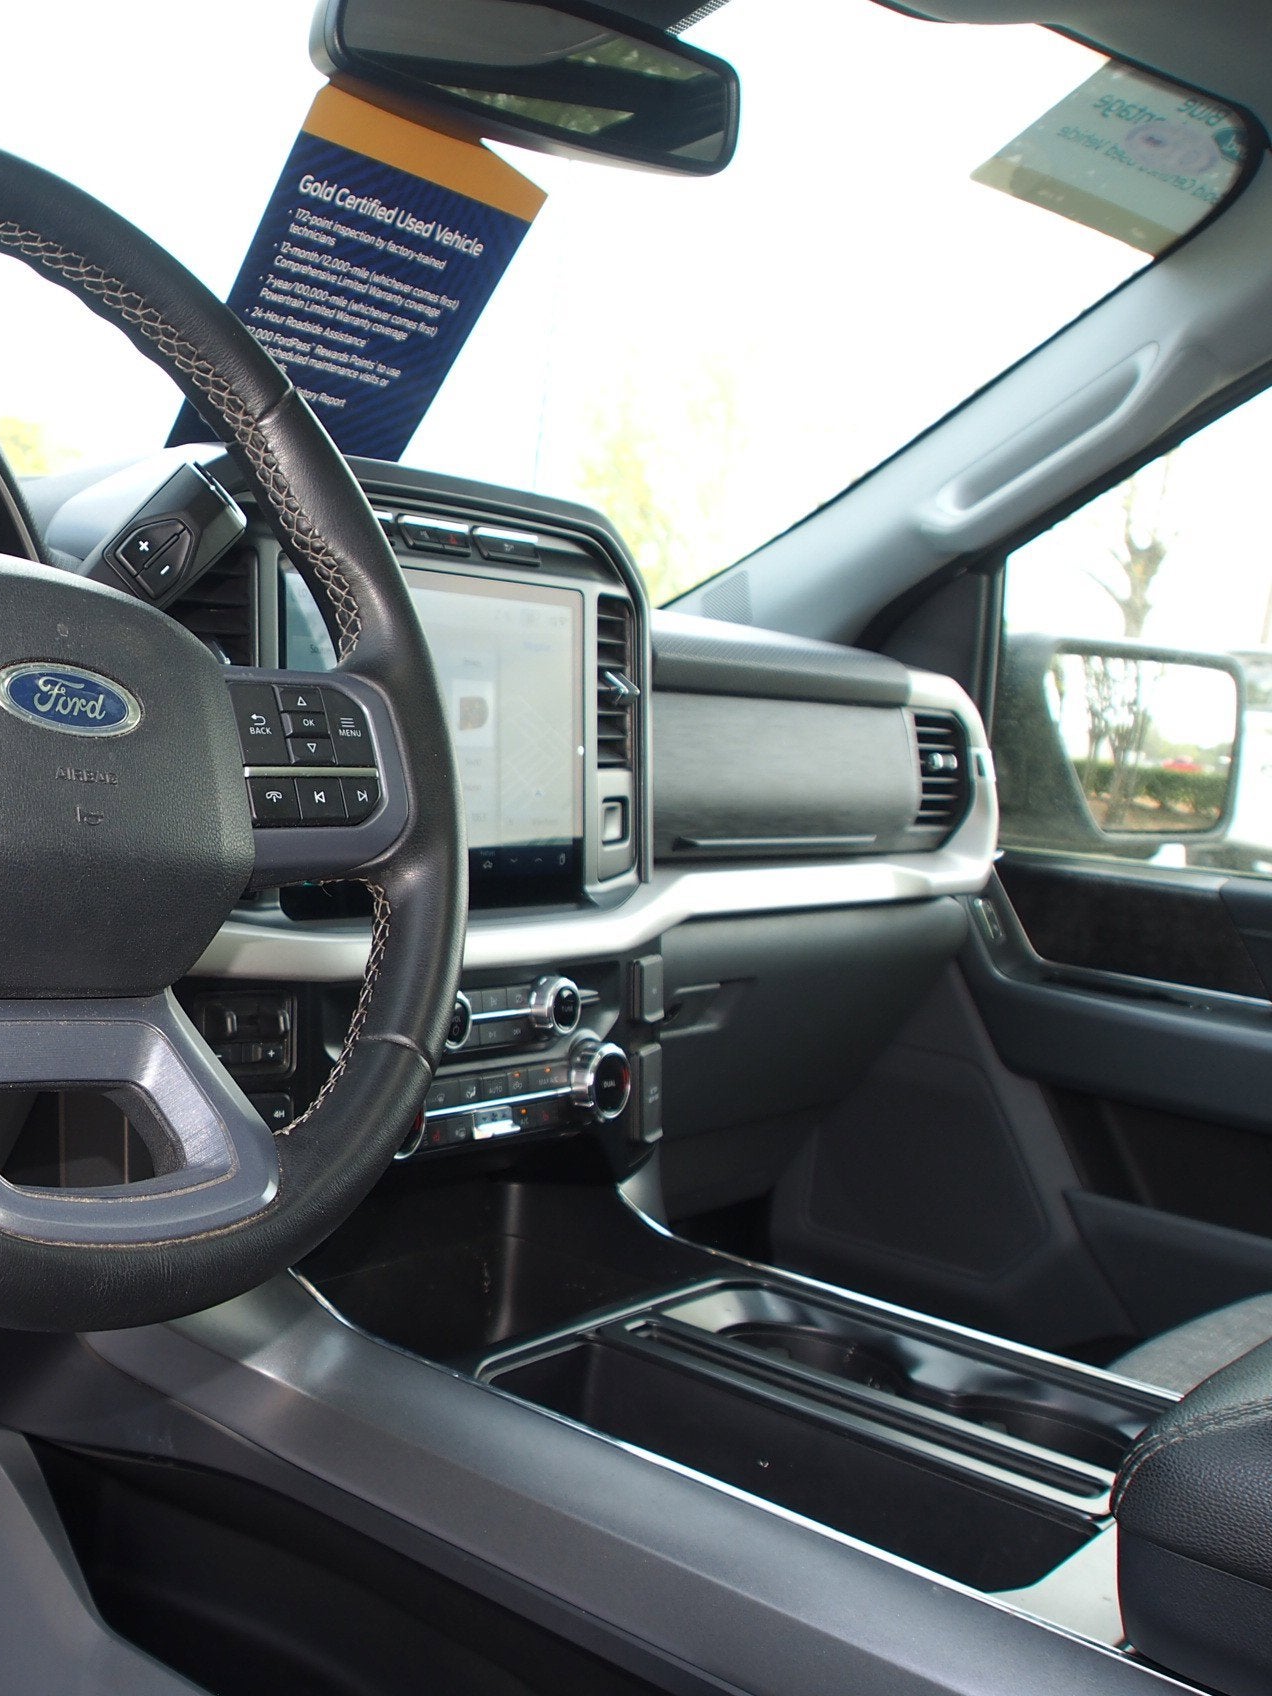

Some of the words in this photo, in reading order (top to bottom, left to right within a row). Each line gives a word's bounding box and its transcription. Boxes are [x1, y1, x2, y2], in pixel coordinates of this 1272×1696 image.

[299, 175, 337, 201] Gold
[335, 188, 398, 225] Certified
[396, 210, 436, 238] Used
[434, 224, 484, 256] Vehicle
[289, 222, 337, 246] technicians
[295, 208, 333, 230] 172-point
[332, 221, 376, 245] inspection
[375, 236, 387, 249] by
[387, 240, 447, 270] factory-trained
[274, 255, 338, 283] Comprehensive
[338, 275, 369, 292] Limited
[368, 285, 405, 306] Warranty
[369, 271, 413, 292] (whichever
[412, 287, 440, 302] comes
[439, 294, 460, 310] first)
[251, 306, 286, 324] 24-Hour
[285, 315, 324, 333] Roadside
[259, 287, 305, 309] Powertrain
[305, 300, 337, 318] Limited
[335, 308, 373, 330] Warranty
[348, 299, 392, 320] (whichever
[391, 315, 418, 330] comes
[417, 321, 438, 337] first)
[267, 347, 310, 365] scheduled
[308, 358, 359, 379] maintenance
[358, 372, 380, 384] visits
[379, 378, 390, 387] or
[315, 344, 350, 362] Rewards
[376, 363, 387, 373] to
[386, 367, 402, 378] use
[318, 392, 347, 407] Report
[33, 676, 106, 720] Ford
[249, 726, 272, 735] BACK
[302, 719, 315, 727] OK
[338, 729, 361, 738] MENU
[55, 766, 118, 785] AIRBAG
[603, 1080, 616, 1088] DUAL
[273, 1110, 285, 1118] 4H
